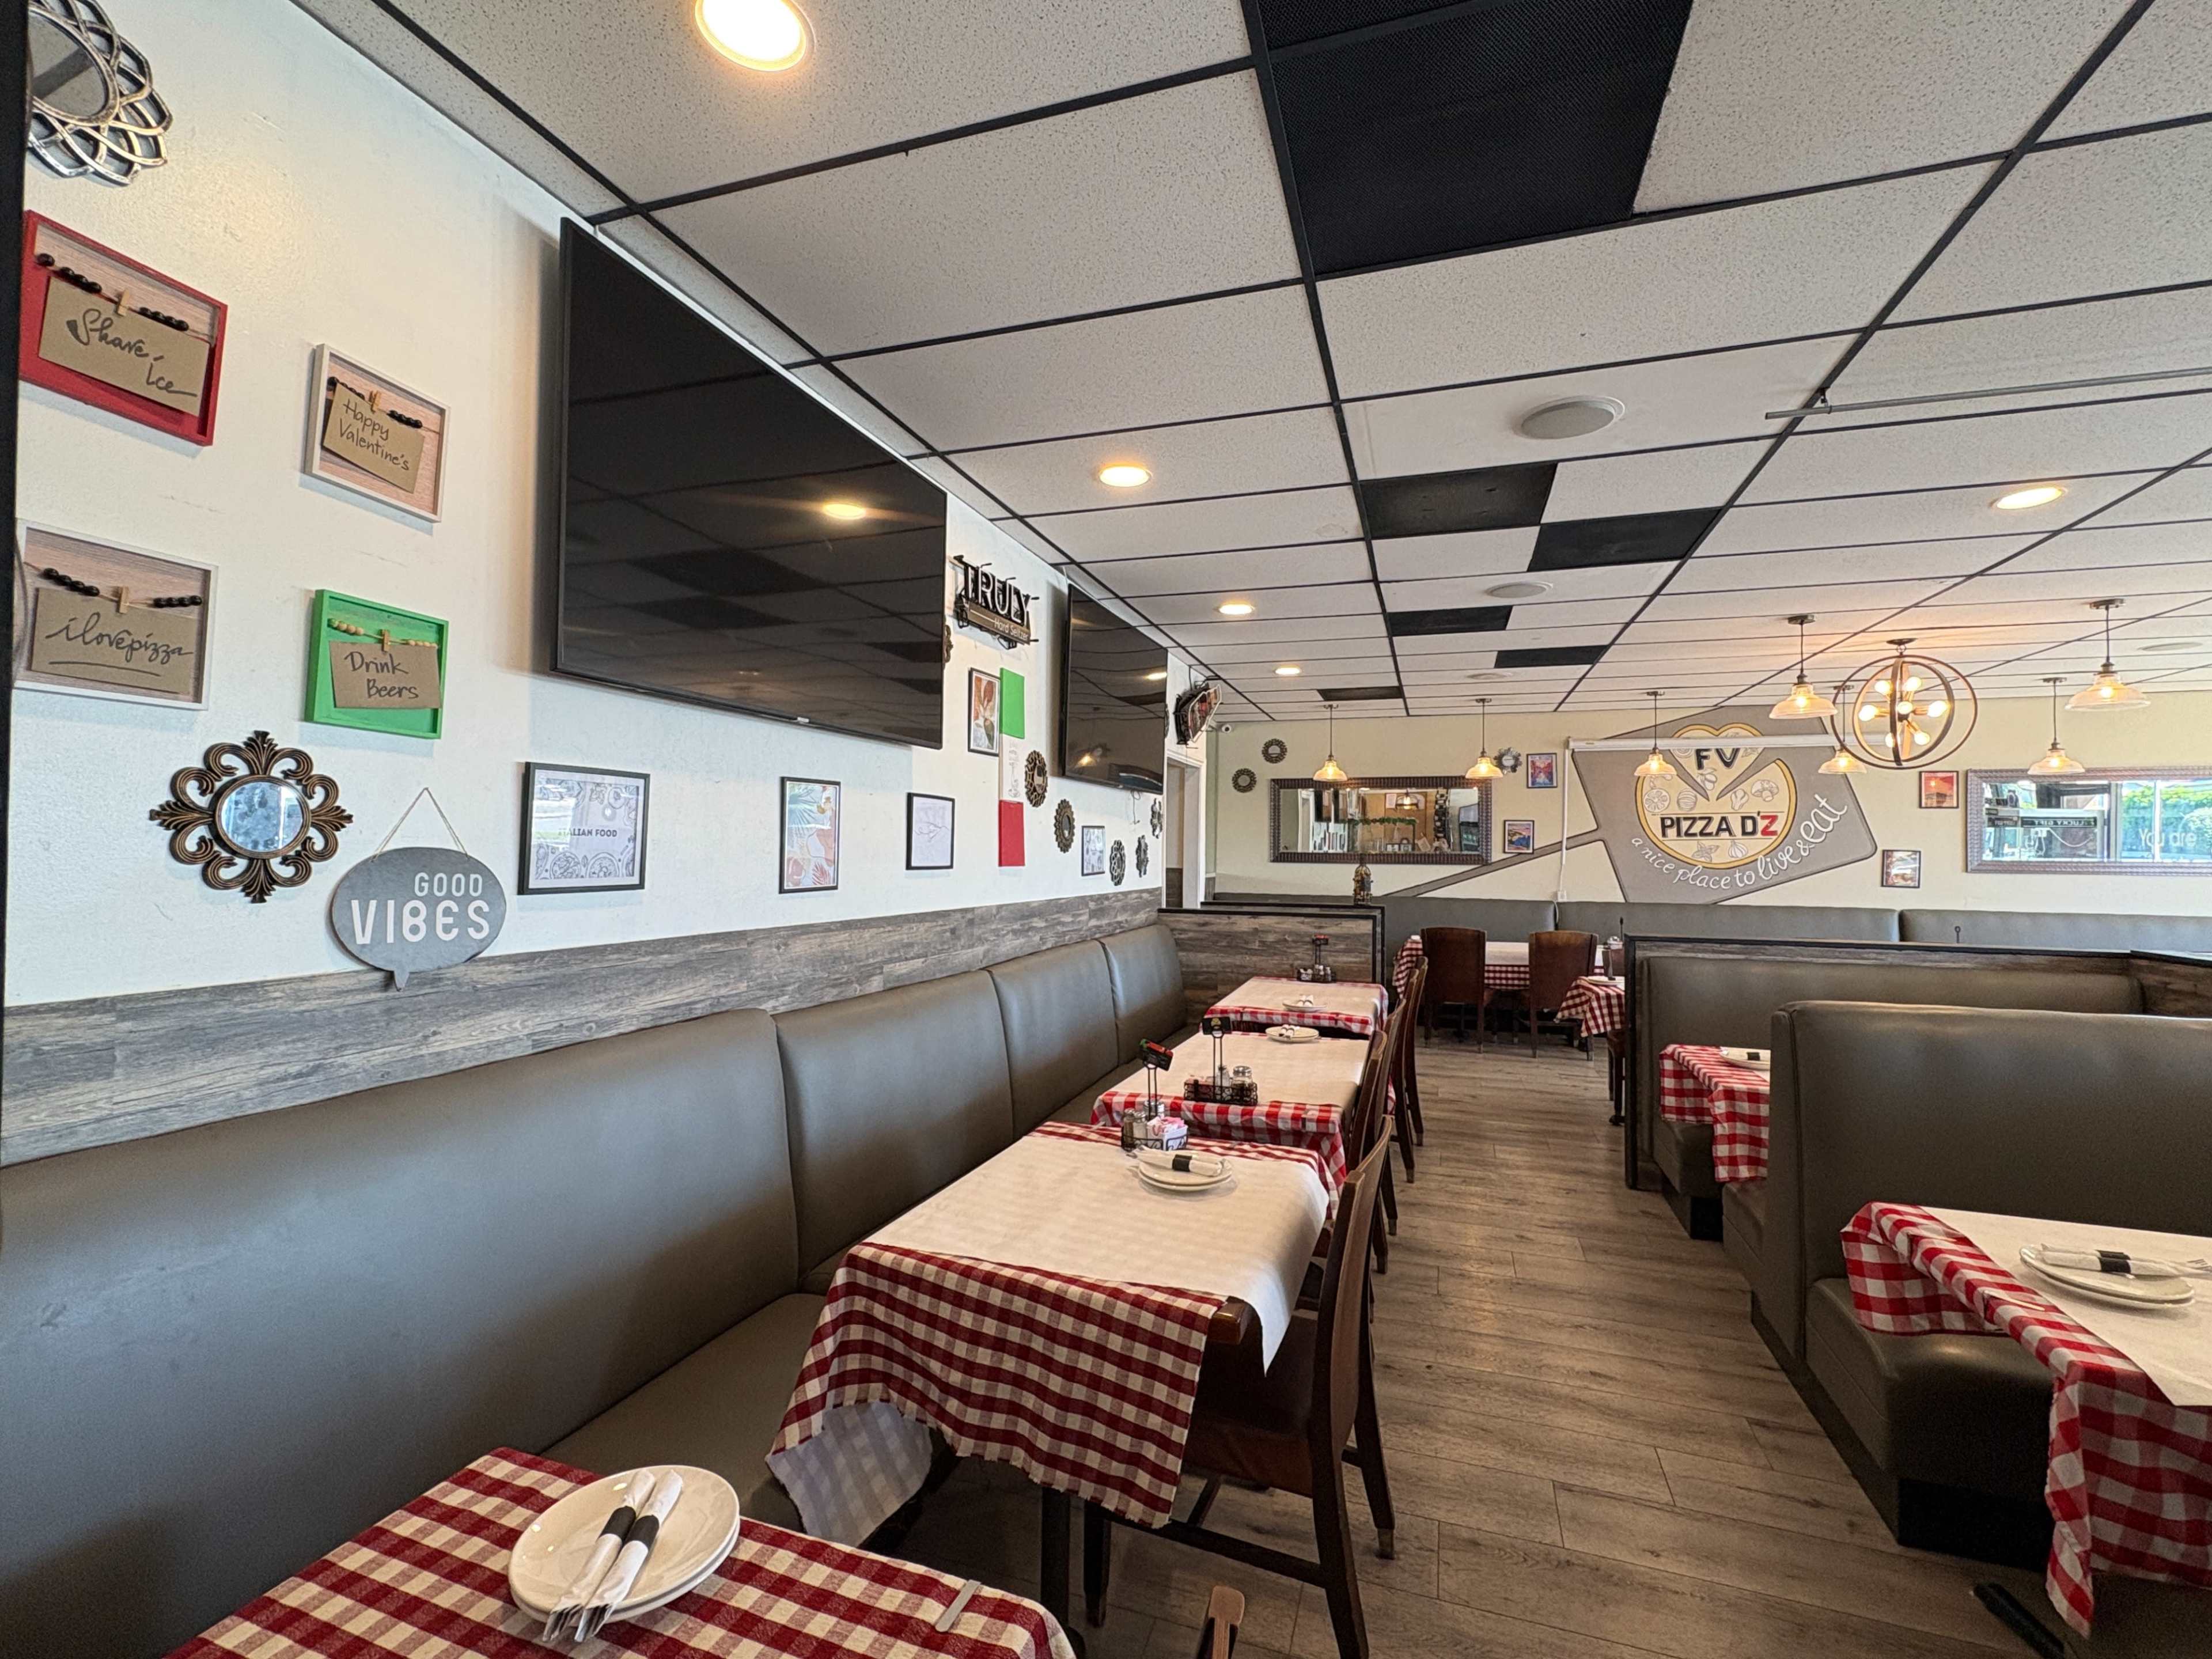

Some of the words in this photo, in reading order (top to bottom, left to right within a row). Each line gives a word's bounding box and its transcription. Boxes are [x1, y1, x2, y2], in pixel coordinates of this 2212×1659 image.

[343, 399, 389, 441] Happy
[340, 418, 410, 471] Valentine's
[963, 565, 1031, 628] TRULY
[995, 618, 1009, 632] Hard
[1011, 627, 1029, 641] Seltzer
[344, 651, 409, 675] Drink
[367, 678, 419, 699] Beers
[595, 829, 618, 837] FOOD
[1660, 816, 1736, 838] PIZZA
[1741, 811, 1778, 837] D'Z
[1631, 838, 1642, 847] a
[1642, 847, 1675, 873] nice
[1673, 865, 1730, 889] place
[1734, 869, 1755, 887] to
[1757, 846, 1801, 880] live
[1801, 794, 1847, 843] eat
[2169, 832, 2197, 847] are
[414, 872, 483, 897] GOOD
[351, 900, 489, 945] VIBES
